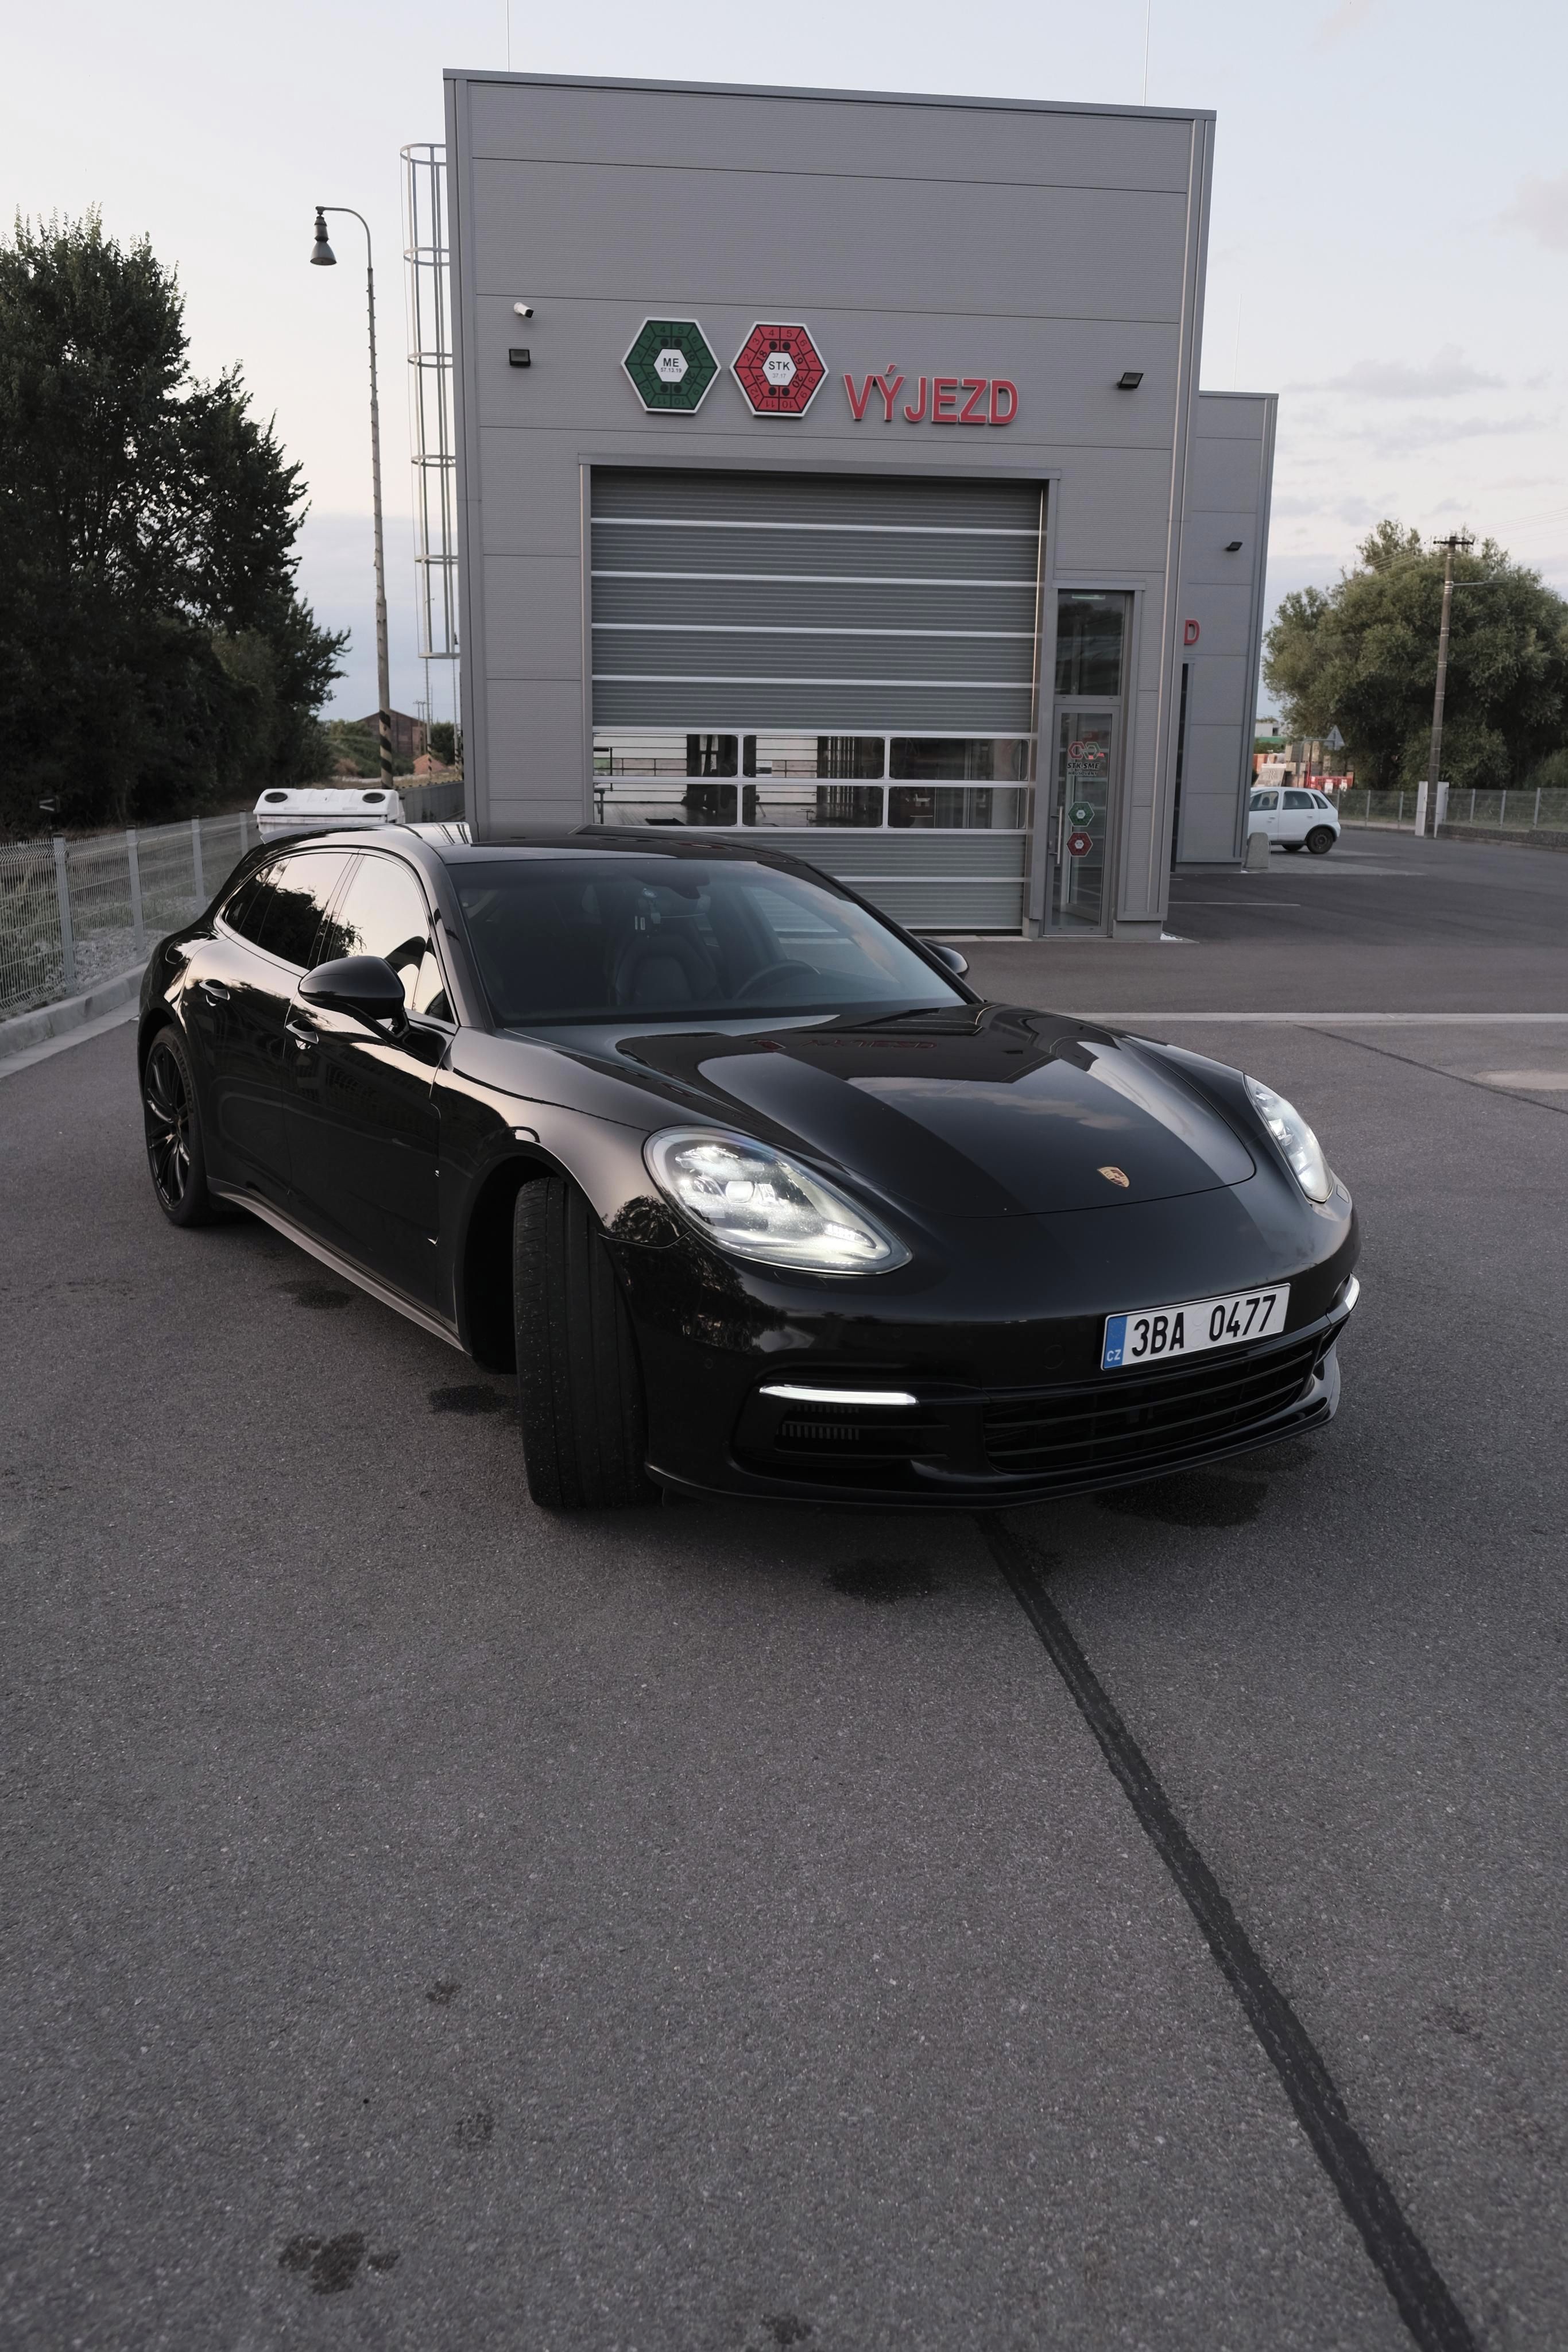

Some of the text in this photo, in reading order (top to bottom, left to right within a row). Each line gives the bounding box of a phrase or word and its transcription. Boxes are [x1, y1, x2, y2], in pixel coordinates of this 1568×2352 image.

[663, 357, 679, 367] ME
[744, 354, 752, 362] 2
[756, 350, 768, 363] 18
[792, 352, 803, 365] 19
[768, 361, 790, 370] STK
[756, 374, 767, 386] 17
[792, 374, 803, 388] 20
[750, 388, 760, 399] 12
[843, 363, 1019, 424] VÝJEZD
[782, 400, 793, 408] 10
[1132, 1294, 1276, 1356] 3BA 0477
[1106, 1349, 1122, 1361] CZ
